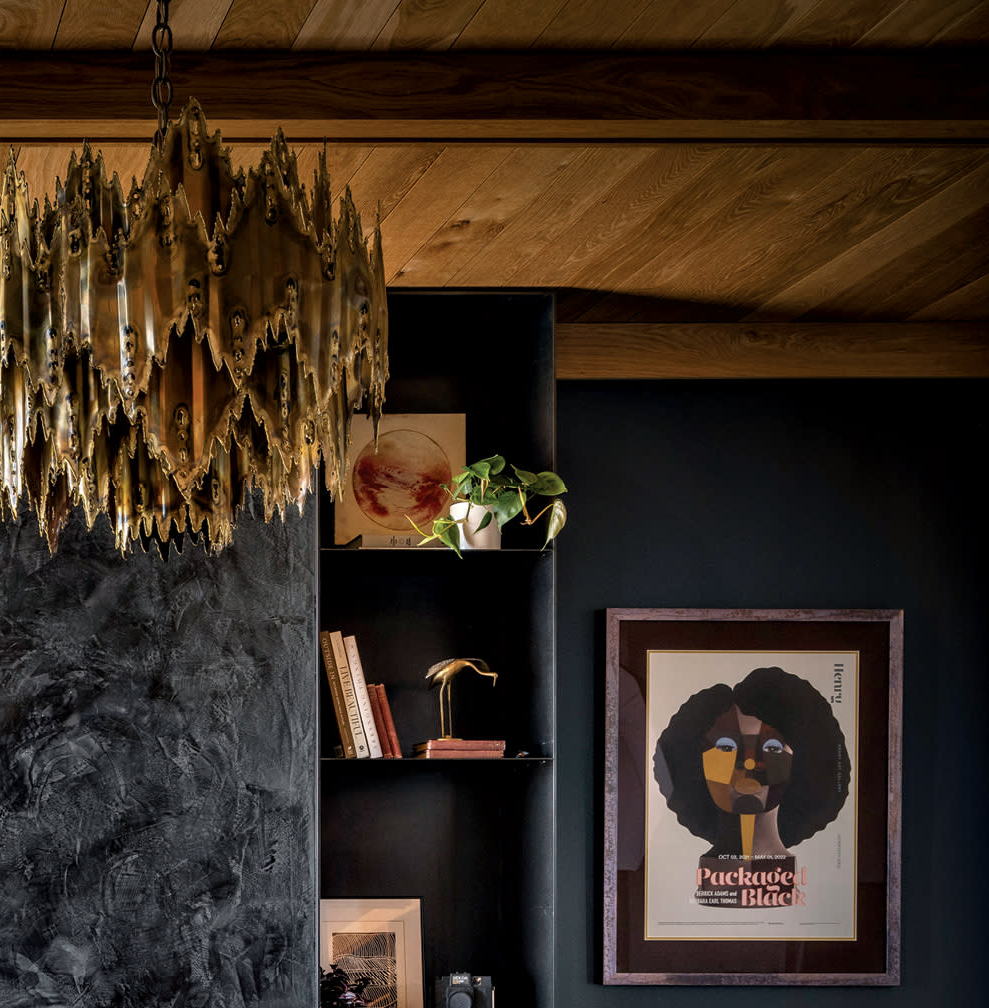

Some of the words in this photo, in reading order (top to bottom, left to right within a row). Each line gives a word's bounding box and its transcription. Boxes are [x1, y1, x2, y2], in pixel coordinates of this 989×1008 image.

[830, 664, 844, 704] Henry
[340, 666, 350, 686] LIVE
[345, 688, 362, 736] BEAUTIFUL
[696, 867, 807, 892] Packaged
[742, 888, 806, 906] Black
